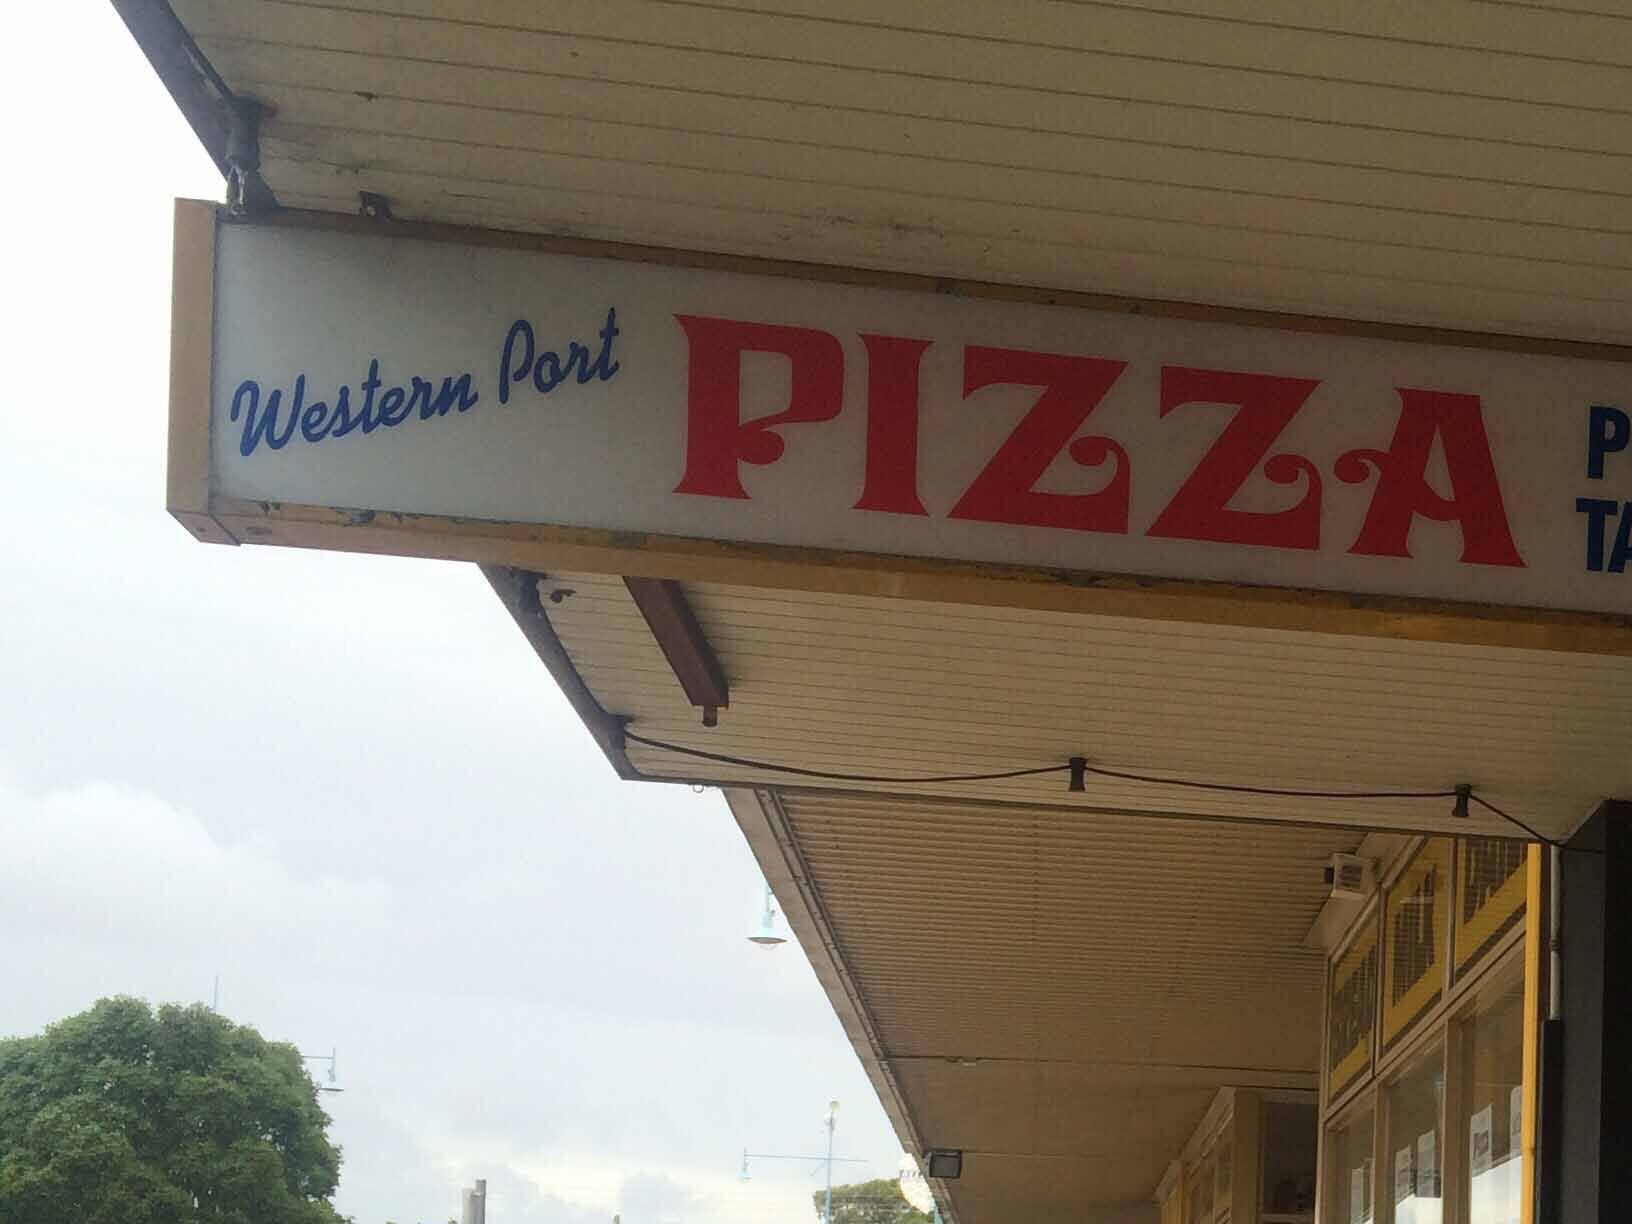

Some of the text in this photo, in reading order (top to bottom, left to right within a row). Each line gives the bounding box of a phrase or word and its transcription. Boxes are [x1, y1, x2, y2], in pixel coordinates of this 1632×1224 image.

[229, 306, 621, 457] Western Port
[673, 314, 1528, 570] PIZZA
